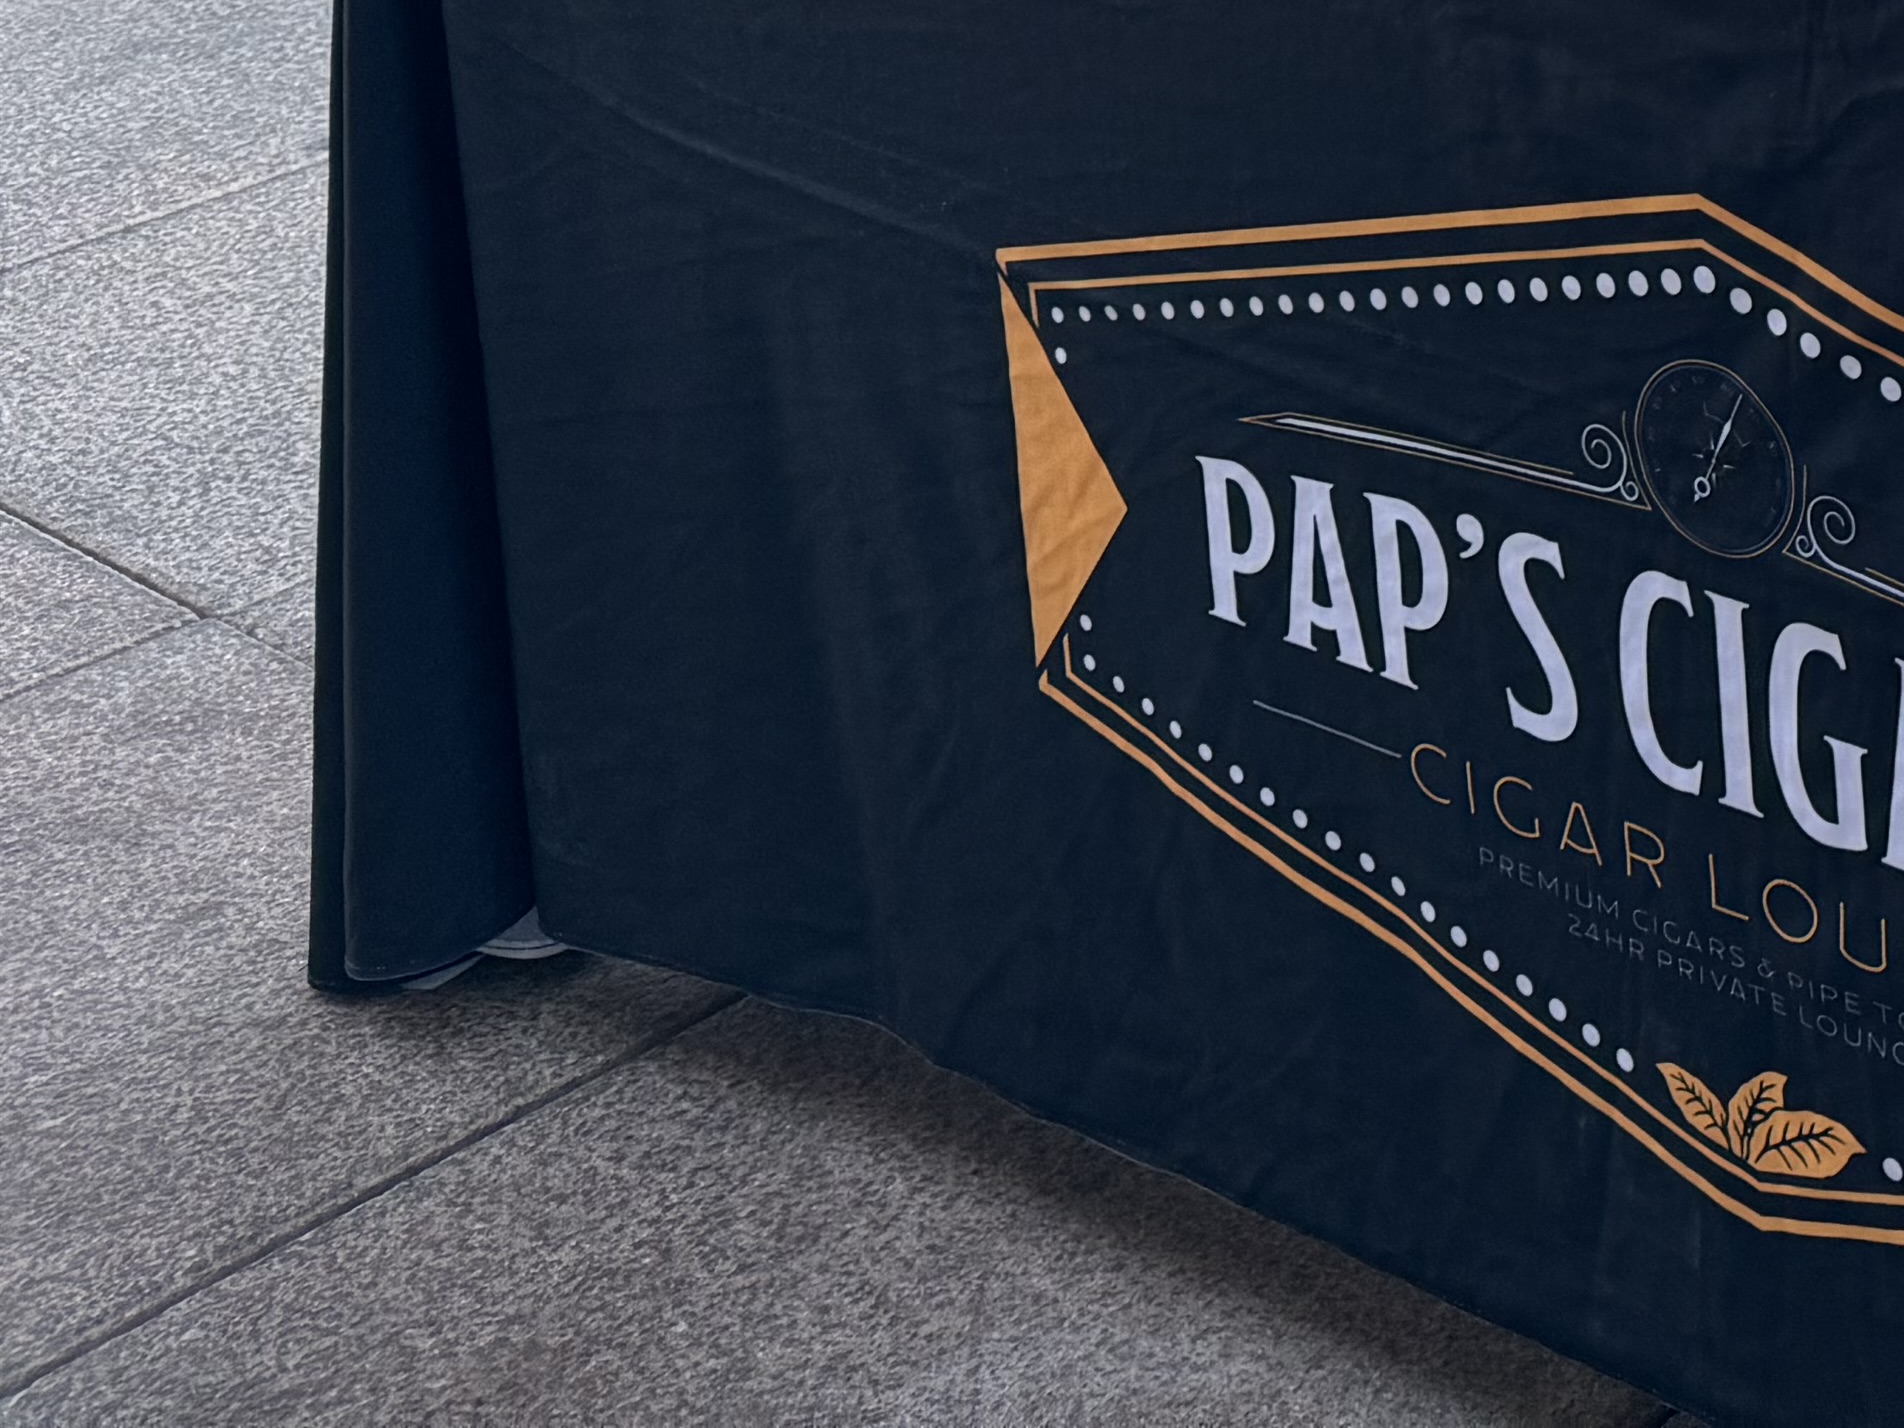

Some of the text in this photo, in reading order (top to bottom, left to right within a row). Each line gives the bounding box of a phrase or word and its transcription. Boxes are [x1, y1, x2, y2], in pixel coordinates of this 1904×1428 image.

[1193, 452, 1582, 747] PAP'S
[1408, 741, 1665, 889] CIGAR
[1478, 845, 1620, 922] PREMIUM
[1631, 908, 1747, 972] CIGARS
[1756, 958, 1777, 980] &
[1785, 969, 1861, 1016] PIPE
[1567, 913, 1647, 962] 24HR
[1656, 949, 1788, 1017] PRIVATE
